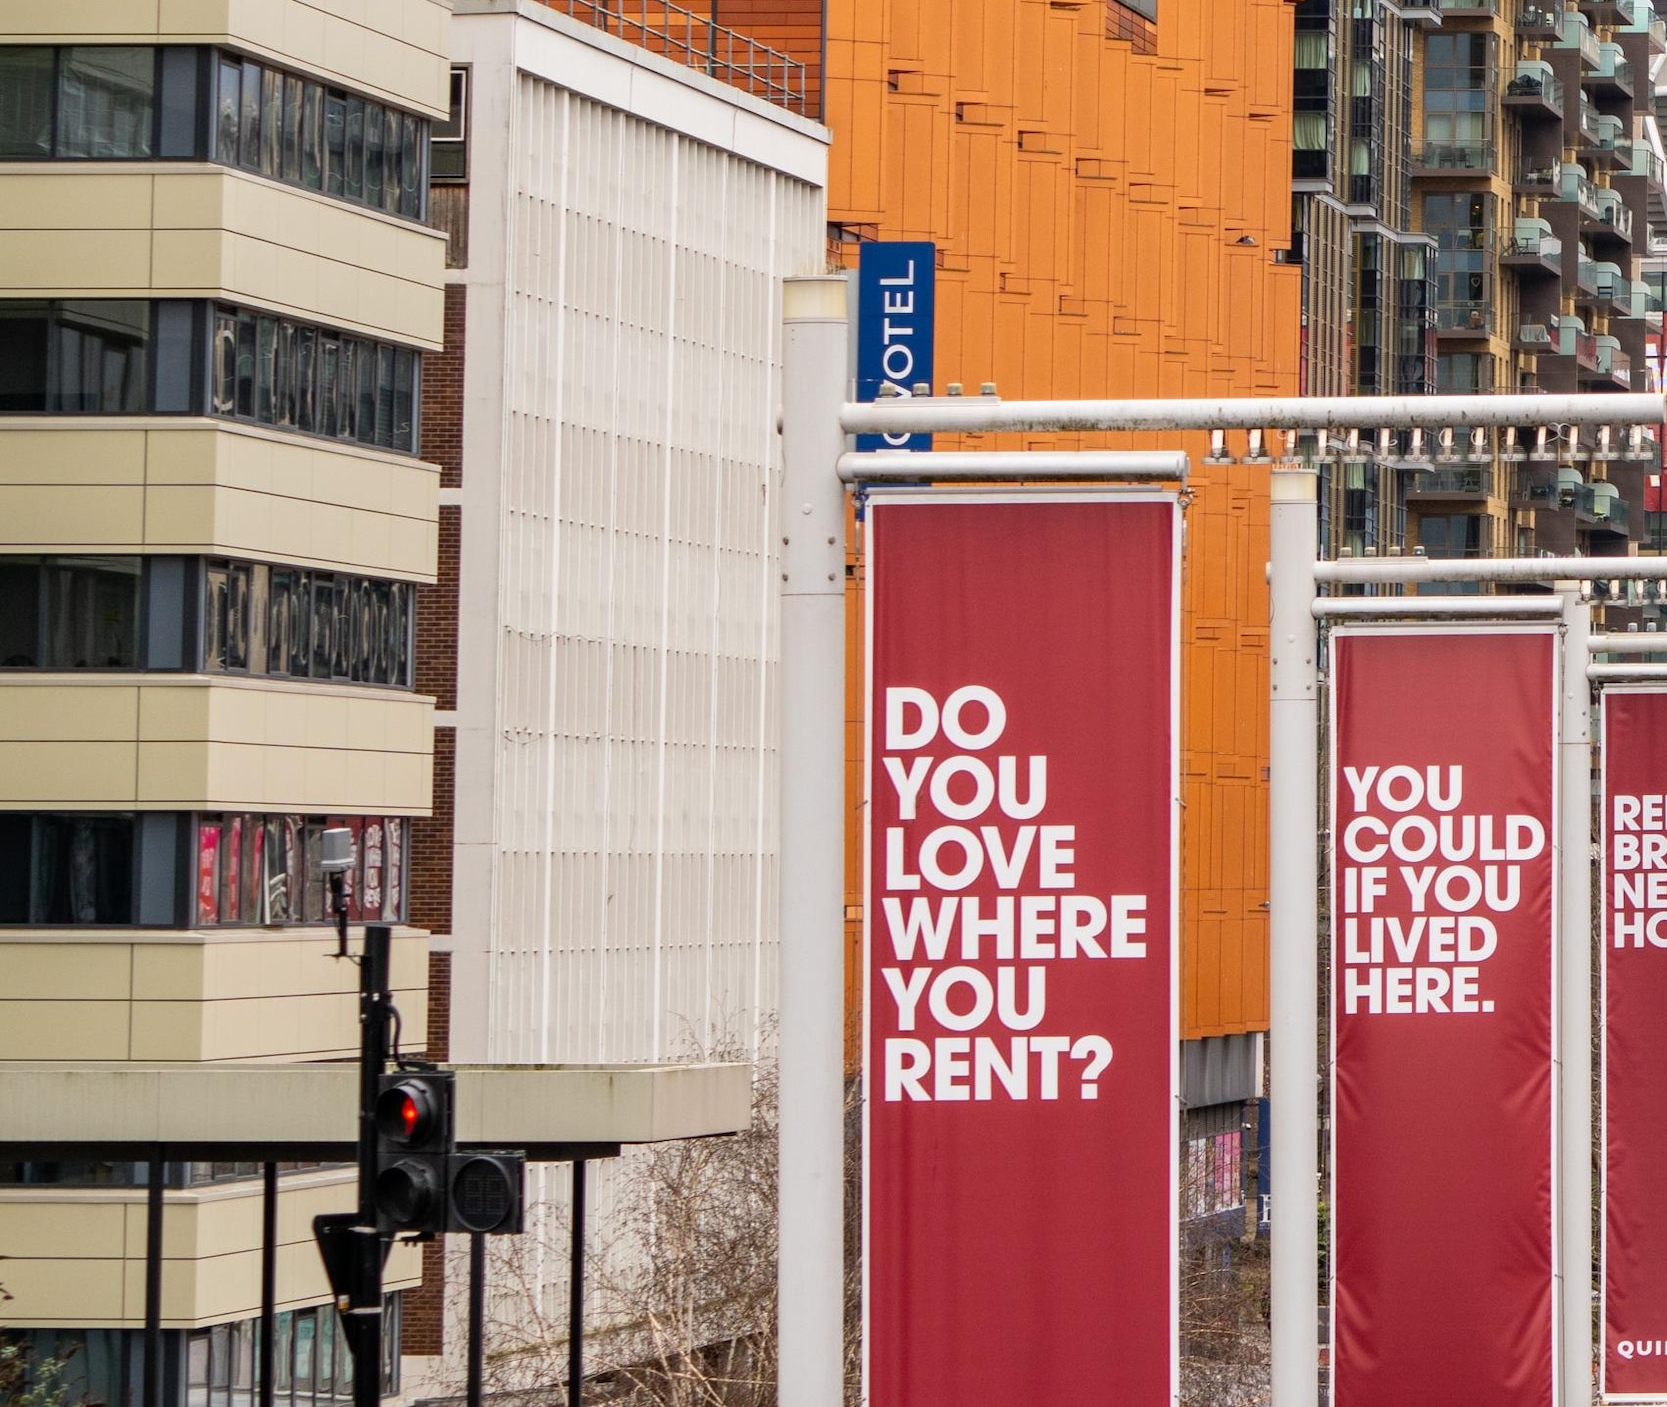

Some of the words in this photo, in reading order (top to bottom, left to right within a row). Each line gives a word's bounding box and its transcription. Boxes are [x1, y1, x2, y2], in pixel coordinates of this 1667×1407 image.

[886, 685, 1006, 749] DO
[884, 756, 1046, 820] YOU
[1344, 765, 1462, 812] YOU
[887, 825, 1075, 890] LOVE
[1344, 815, 1545, 863] COULD
[1345, 867, 1387, 912] IF
[1400, 865, 1520, 912] YOU
[883, 895, 1146, 960] WHERE
[1346, 916, 1497, 963] LIVED
[882, 966, 1045, 1031] YOU
[1345, 967, 1494, 1014] HERE.
[886, 1035, 1113, 1101] RENT?
